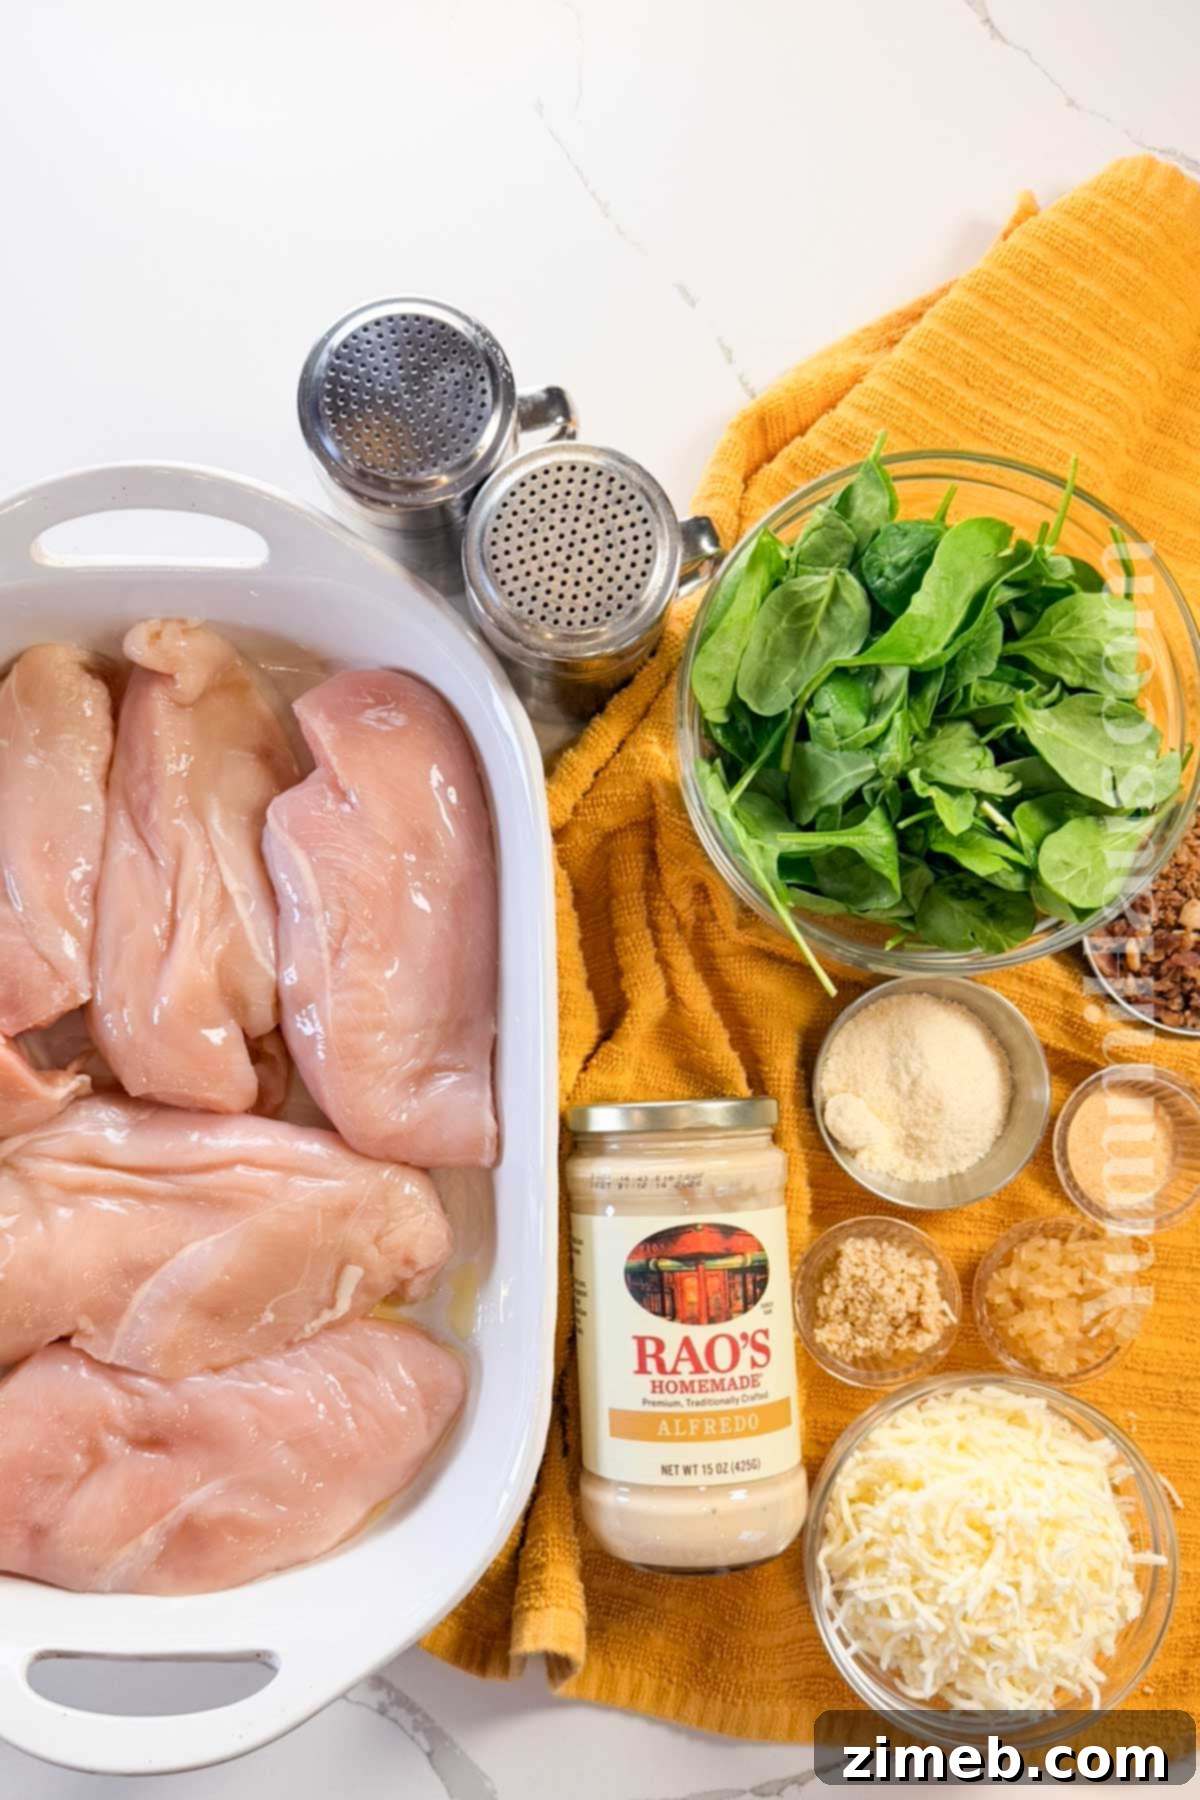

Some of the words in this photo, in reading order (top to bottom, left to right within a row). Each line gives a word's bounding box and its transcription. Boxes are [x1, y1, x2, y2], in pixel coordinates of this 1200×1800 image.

[631, 1328, 772, 1376] RAO'S
[650, 1374, 762, 1395] HOMEMADE
[642, 1398, 684, 1408] Premium,
[687, 1397, 740, 1407] Traditionally
[741, 1391, 769, 1404] Crafted
[656, 1412, 760, 1437] ALFREDO
[660, 1464, 680, 1476] NET
[682, 1464, 698, 1476] WT
[702, 1462, 713, 1475] 15
[715, 1462, 729, 1474] OZ
[731, 1457, 761, 1474] (425G)
